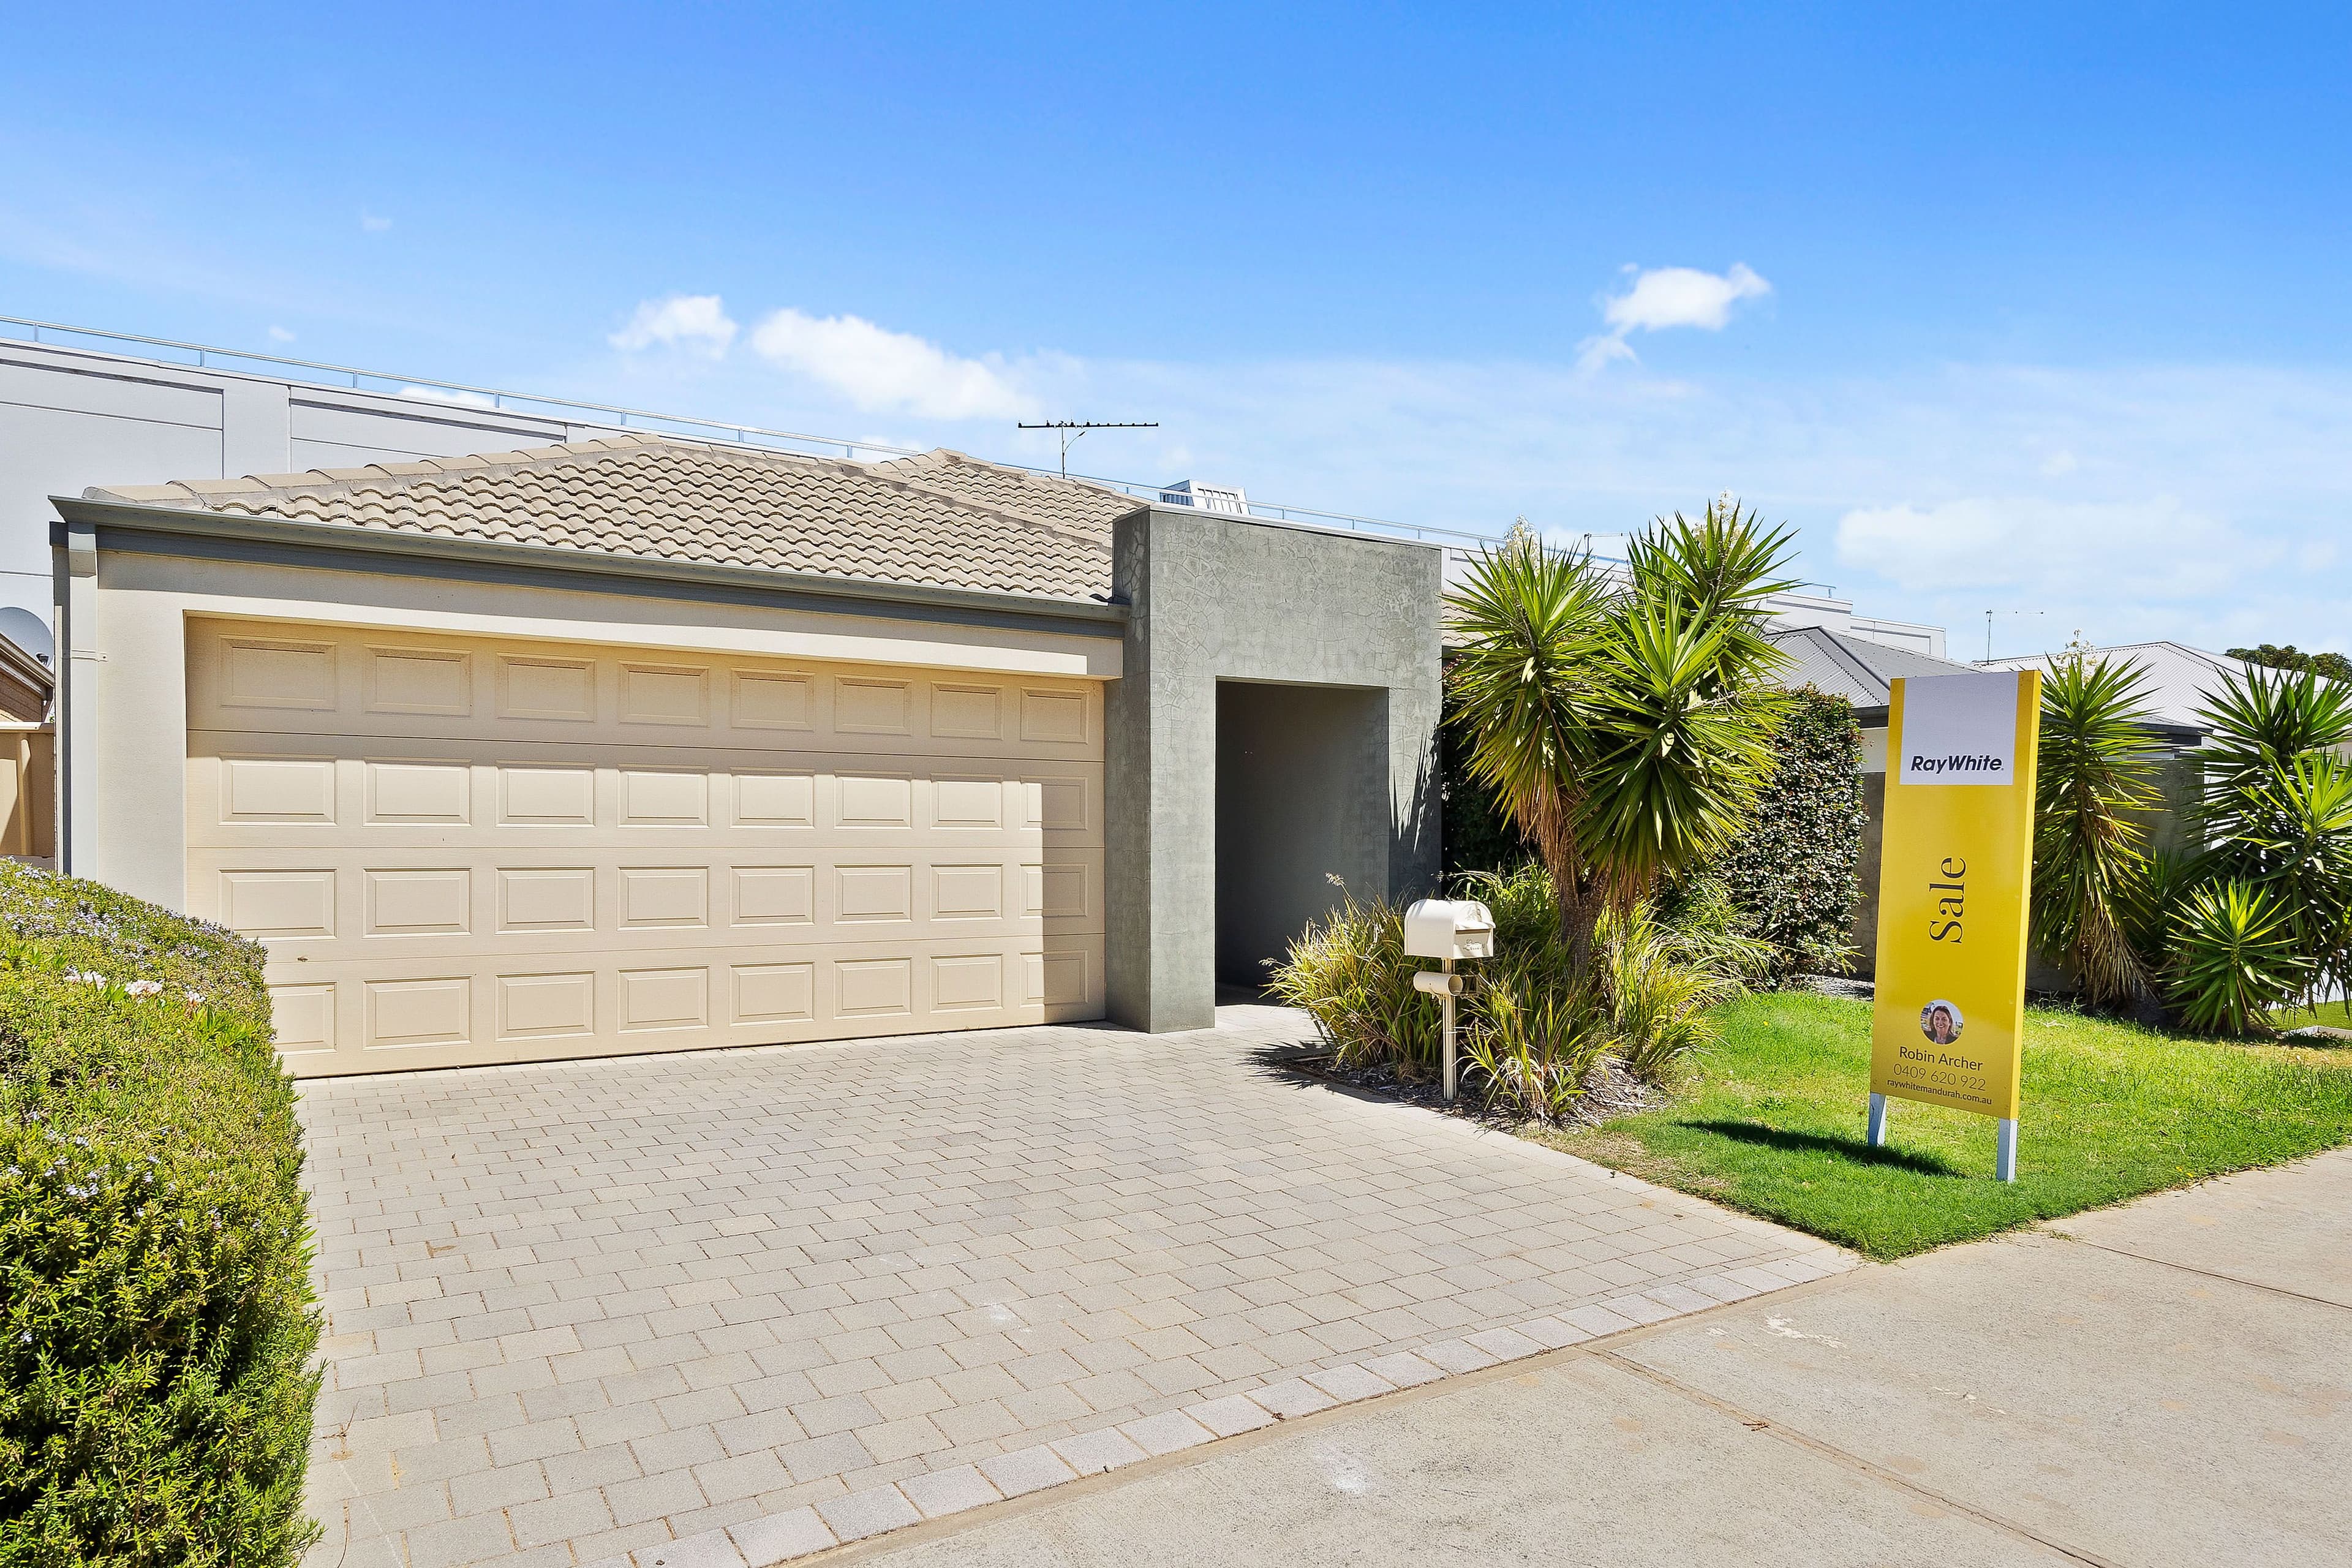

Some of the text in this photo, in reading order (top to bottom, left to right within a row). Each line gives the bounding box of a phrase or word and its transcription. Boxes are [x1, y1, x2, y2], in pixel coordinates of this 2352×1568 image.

[1929, 858, 1966, 943] Sale
[1899, 1046, 1983, 1071] Robin Archer
[1893, 1063, 1986, 1091] 0409 620 922
[1887, 1079, 1992, 1105] raywhitemandurah.com.au
